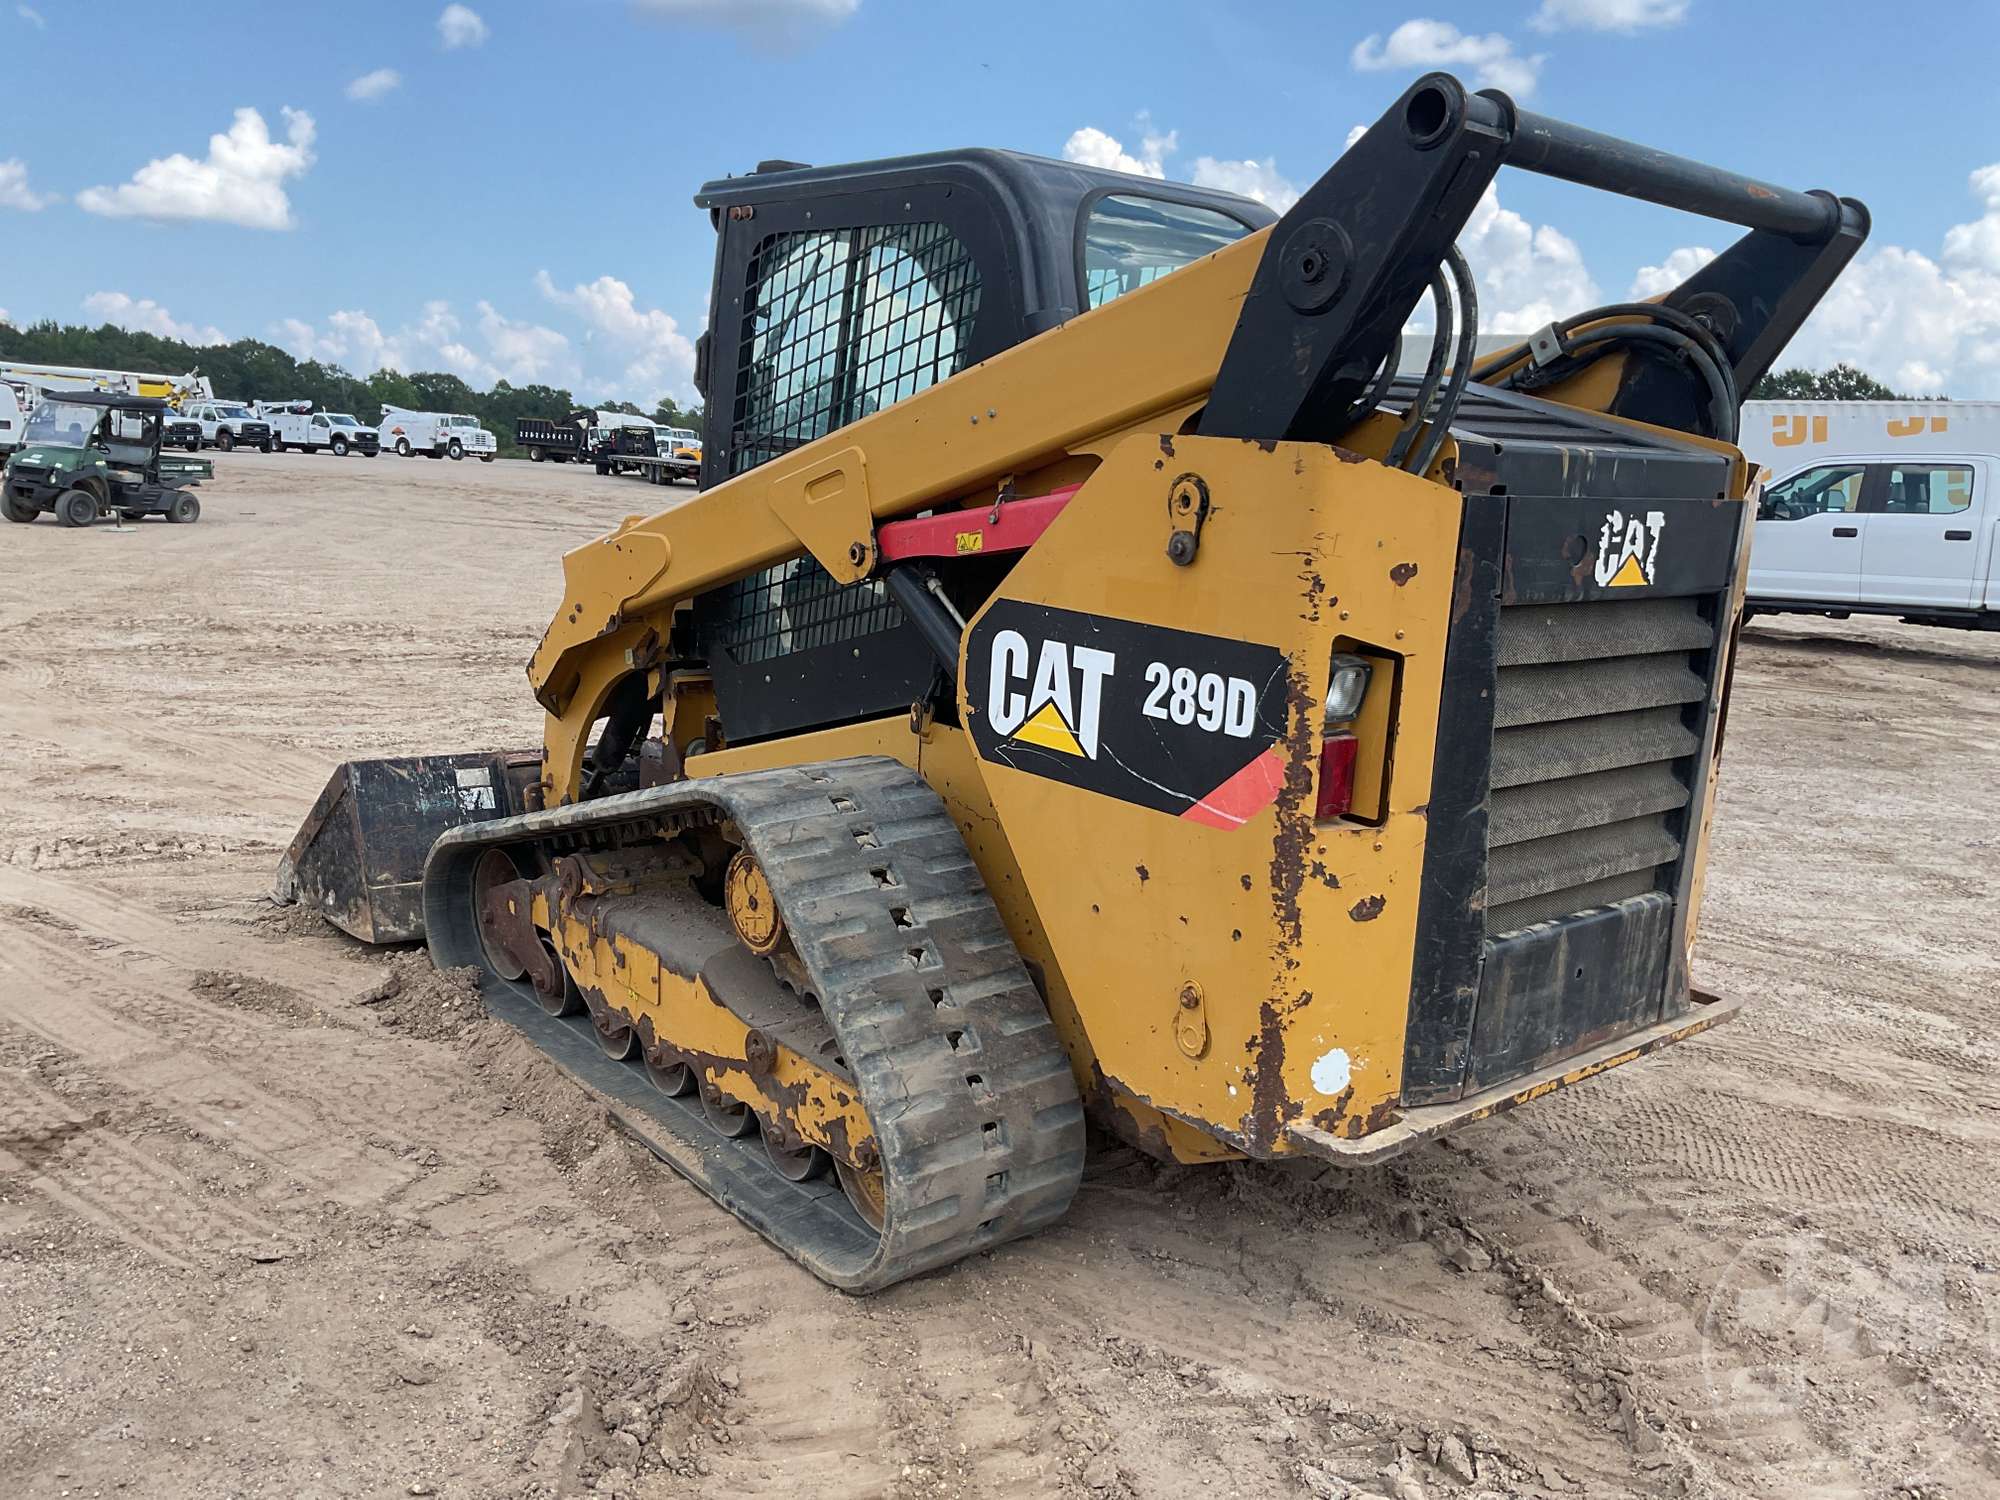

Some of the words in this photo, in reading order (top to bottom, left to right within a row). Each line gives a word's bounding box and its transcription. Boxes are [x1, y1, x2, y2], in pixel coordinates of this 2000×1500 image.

[1594, 510, 1666, 587] CAT
[988, 630, 1116, 760] CAT
[1142, 662, 1257, 738] 289D
